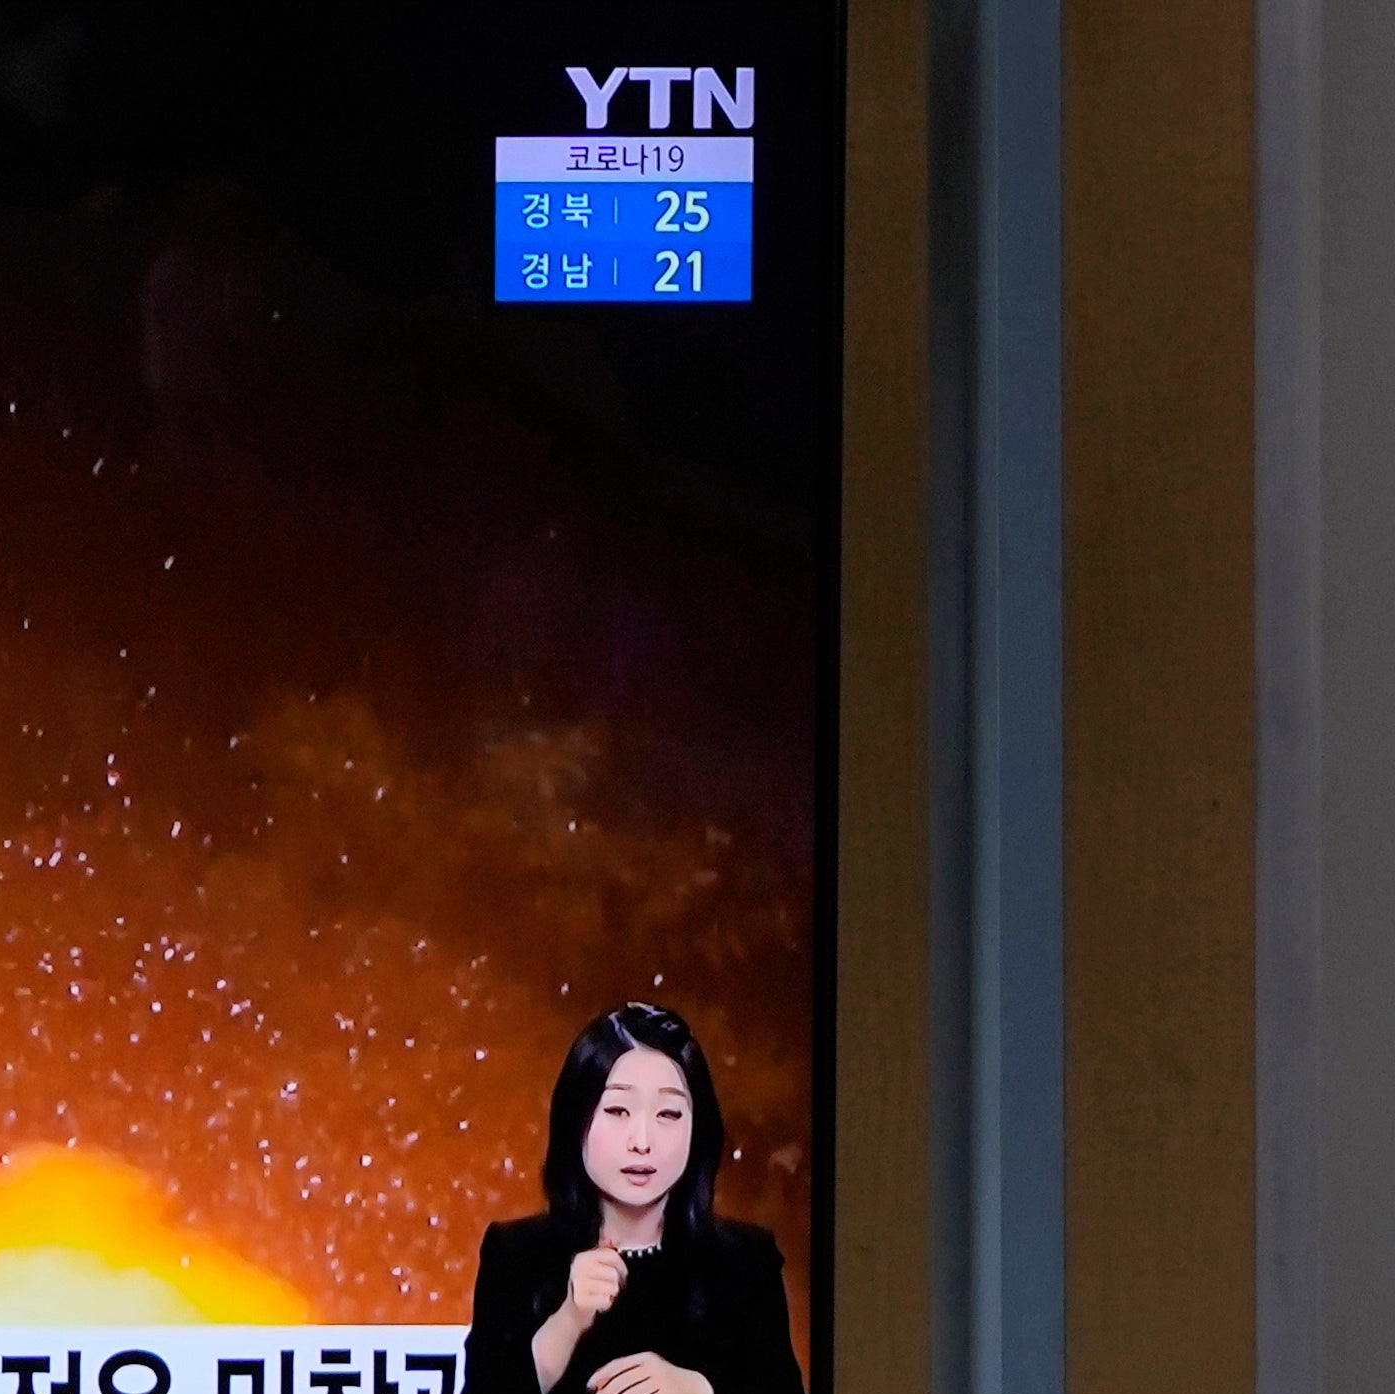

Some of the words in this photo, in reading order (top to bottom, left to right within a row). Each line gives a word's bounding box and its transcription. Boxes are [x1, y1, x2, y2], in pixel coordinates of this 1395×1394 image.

[566, 67, 754, 129] YTN
[567, 145, 684, 174] 코로나19
[656, 191, 709, 231] 25
[655, 251, 701, 291] 21
